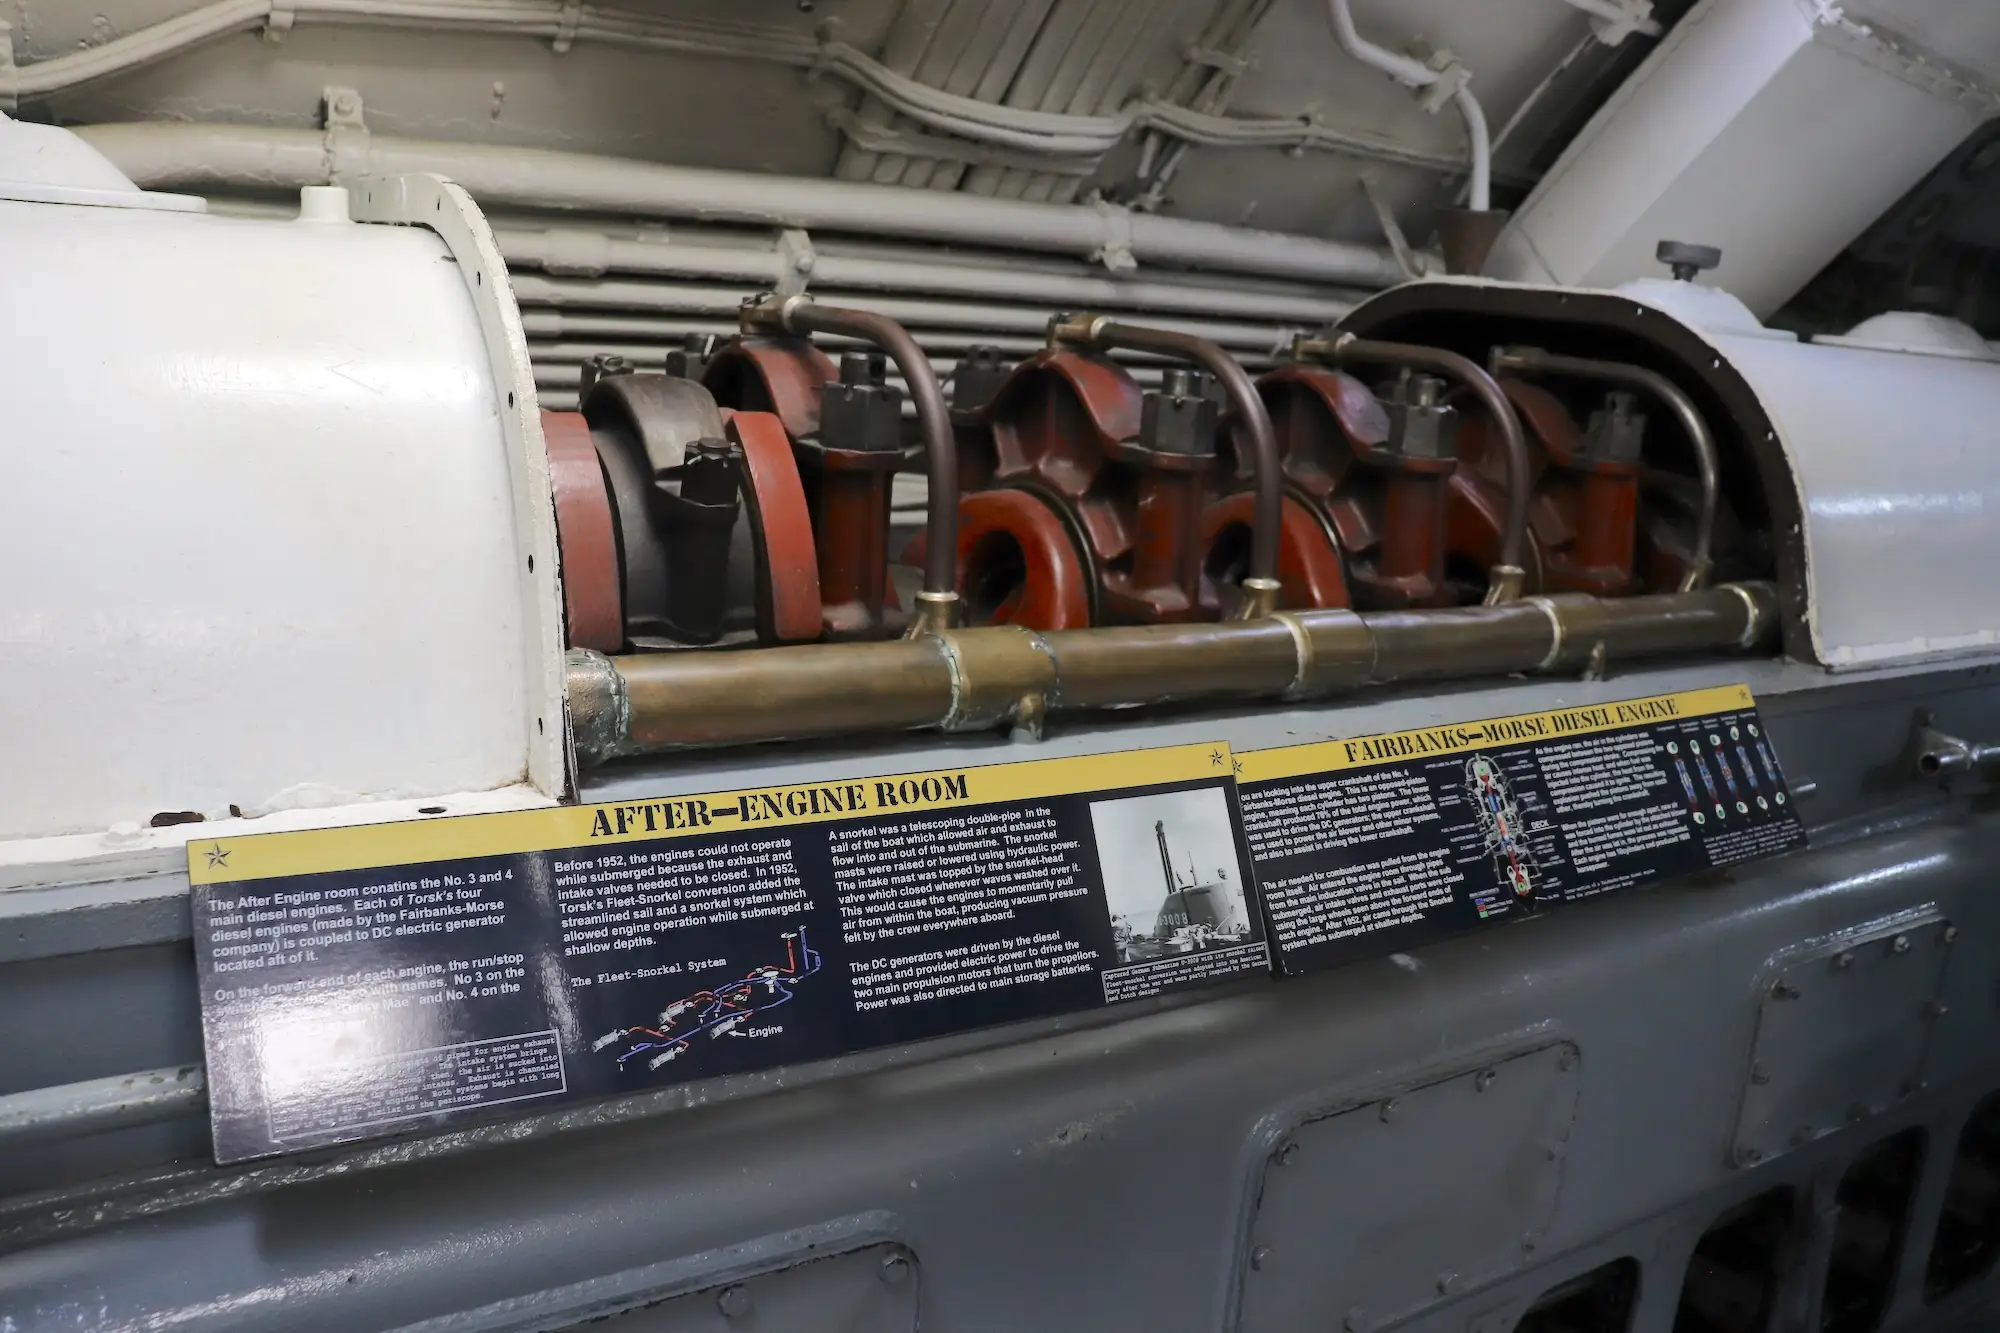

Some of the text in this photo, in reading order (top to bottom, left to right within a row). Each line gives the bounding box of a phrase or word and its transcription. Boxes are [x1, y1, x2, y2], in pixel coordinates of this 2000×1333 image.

[1551, 708, 1614, 732] DIESEL
[1615, 699, 1679, 722] ENGINE
[874, 774, 969, 808] ROOM
[828, 806, 1051, 841] A snorkel was a telescoping double-pipe in the
[829, 818, 1057, 853] sail of the boat which allowed air and exhaust to
[1530, 818, 1549, 829] DECK
[553, 837, 791, 872] Before 1952, the engines could not operate
[831, 829, 1057, 866] flow into and out of the submarine. The snorkel
[833, 840, 1080, 879] masts were raised or lowered using hydraulic power.
[555, 849, 792, 886] while submerged because the exhaust and
[557, 862, 797, 900] intake valves needed to be closed. In 1952,
[207, 868, 513, 911] The After Engine room conatins the No. 3 and 4
[209, 887, 482, 926] main diesel engines. Each of Torsk's four
[558, 875, 801, 913] Torsk's Fleet-Snorkel conversion added the
[211, 900, 504, 942] diesel engines (made by the Fairbanks-Morse
[561, 887, 806, 928] streamlined sail and a snorkel system which
[562, 899, 814, 942] allowed engine operation while submerged at
[212, 914, 505, 957] company) is coupled to DC electric generator
[564, 935, 656, 956] shallow depths.
[213, 949, 318, 973] located aft of it.
[570, 958, 727, 987] The Fleet-Snorkel System
[473, 1047, 489, 1056] for
[491, 1042, 520, 1053] engine
[522, 1036, 555, 1048] exhaust
[748, 1024, 783, 1038] Engine
[456, 1047, 548, 1067] intake system brings
